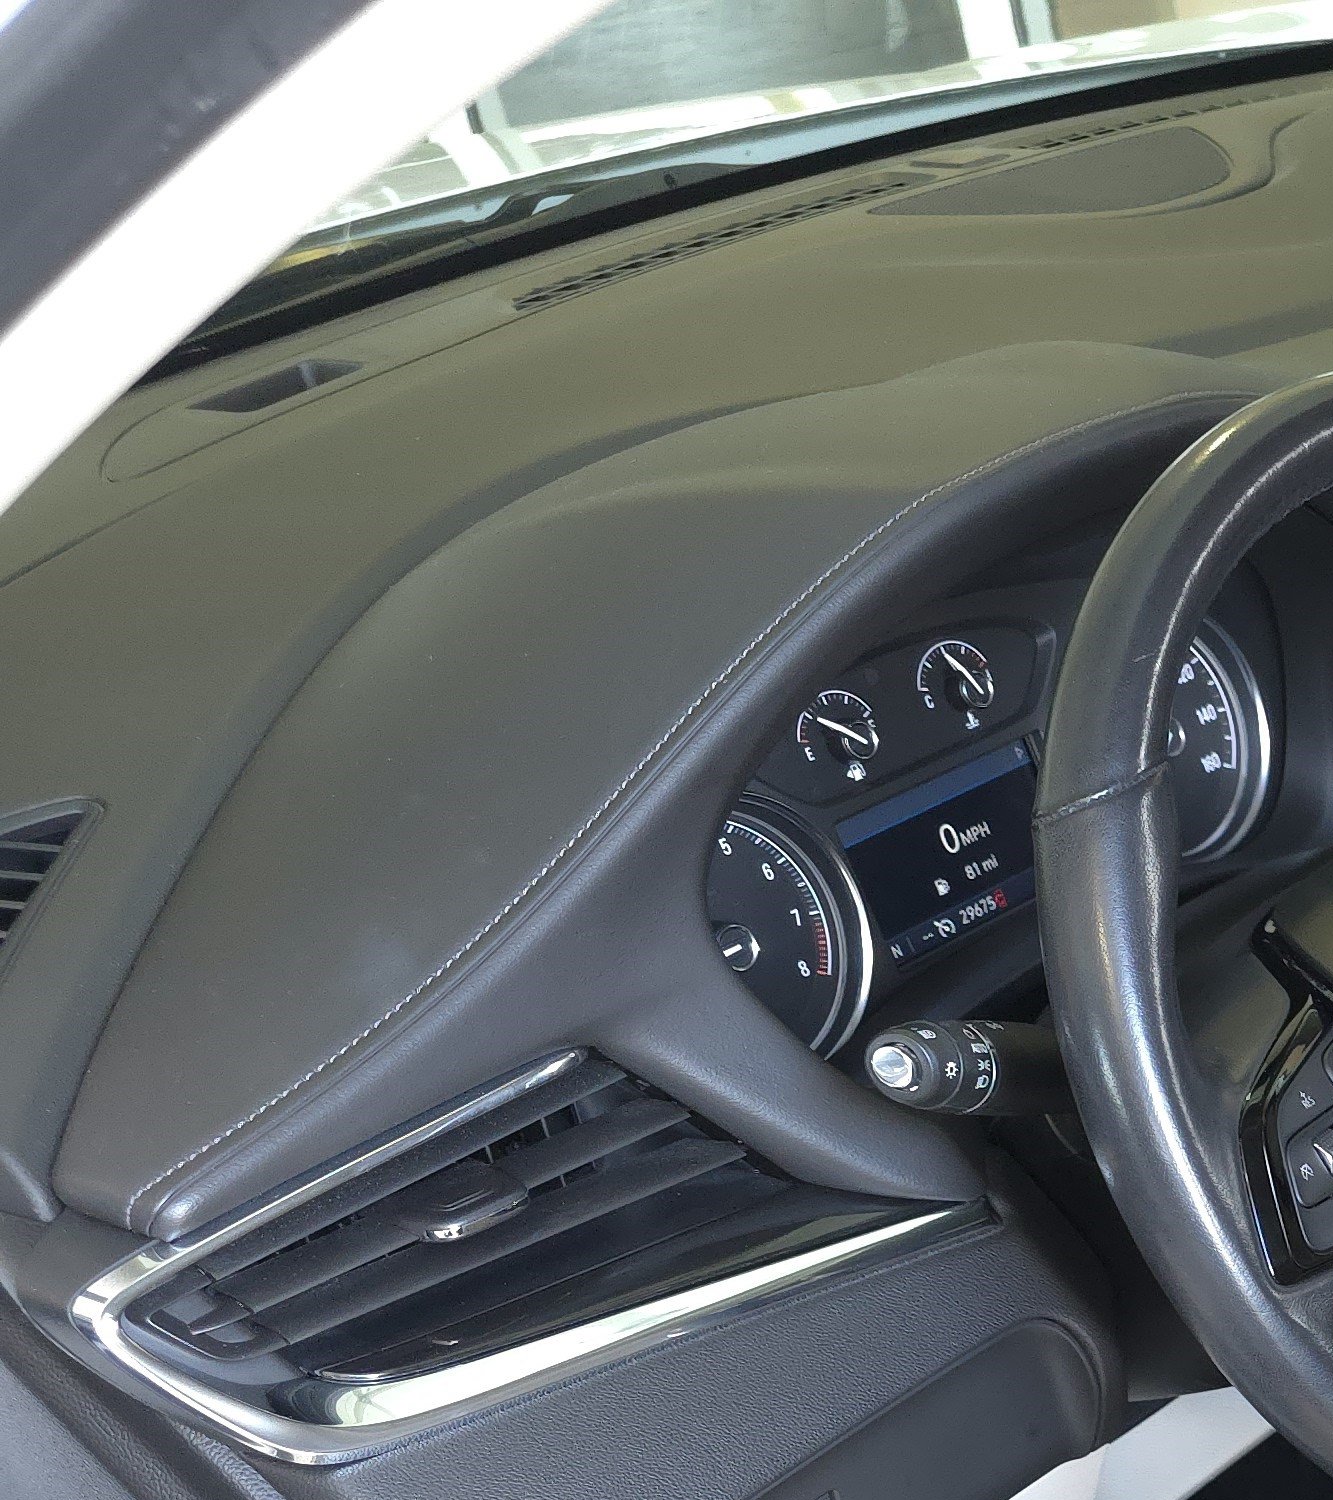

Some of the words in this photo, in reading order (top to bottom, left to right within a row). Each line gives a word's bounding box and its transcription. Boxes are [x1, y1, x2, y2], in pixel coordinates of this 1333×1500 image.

[804, 746, 816, 762] E
[718, 837, 732, 856] 5
[761, 862, 776, 881] 6
[964, 861, 983, 880] 81
[982, 853, 999, 873] mi
[789, 908, 802, 927] 7
[890, 943, 904, 959] N
[797, 959, 811, 977] 8
